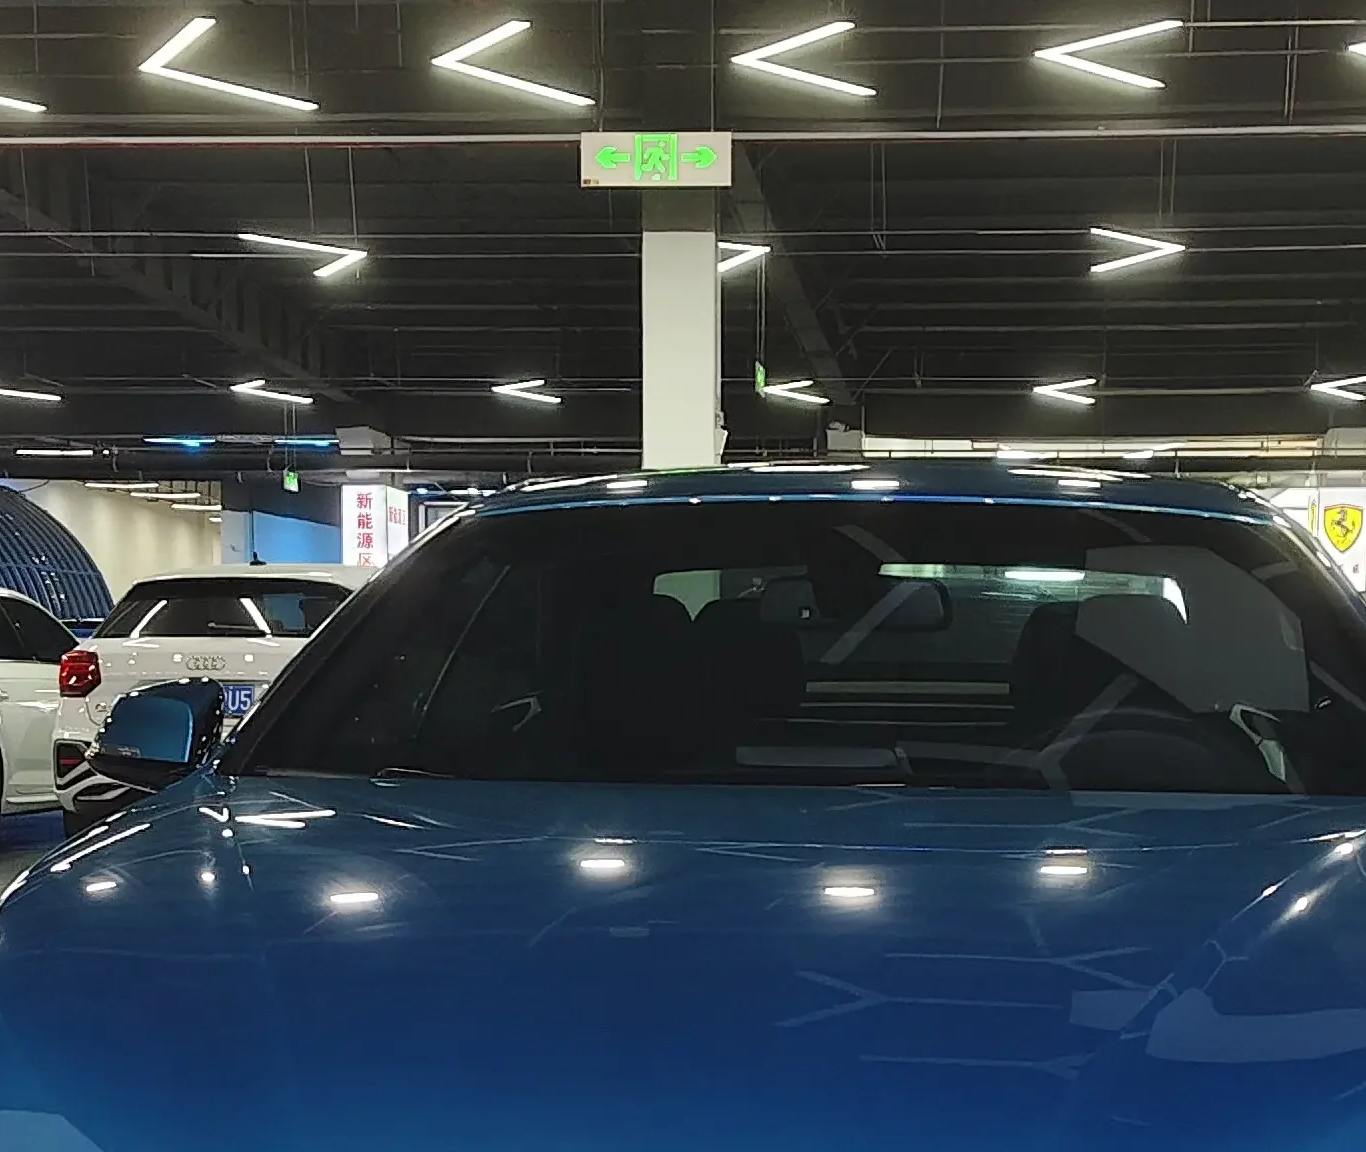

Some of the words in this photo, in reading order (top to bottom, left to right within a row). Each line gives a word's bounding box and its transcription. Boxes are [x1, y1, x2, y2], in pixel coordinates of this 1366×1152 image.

[357, 492, 374, 568] 新能源区
[224, 689, 252, 711] U5
